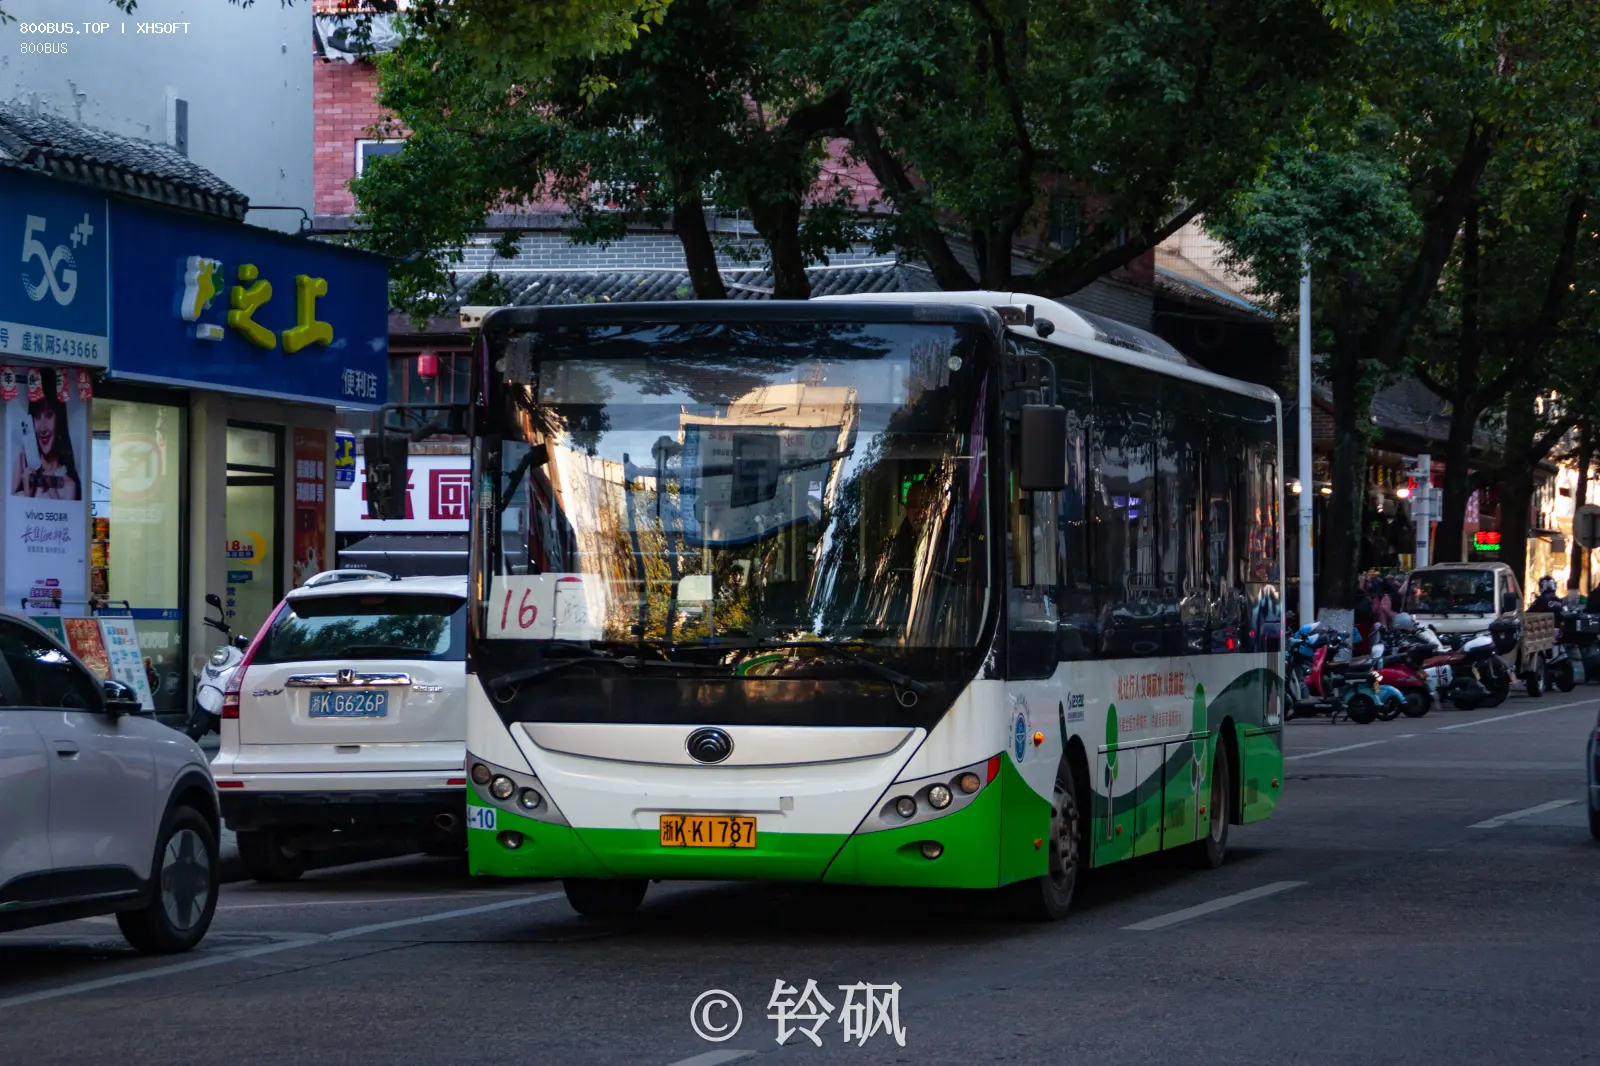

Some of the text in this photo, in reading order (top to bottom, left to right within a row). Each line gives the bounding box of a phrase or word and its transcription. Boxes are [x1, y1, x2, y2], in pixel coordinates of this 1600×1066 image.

[227, 262, 334, 354] 之上
[341, 367, 378, 398] 便利店
[25, 509, 45, 520] vivo
[501, 588, 538, 630] 16
